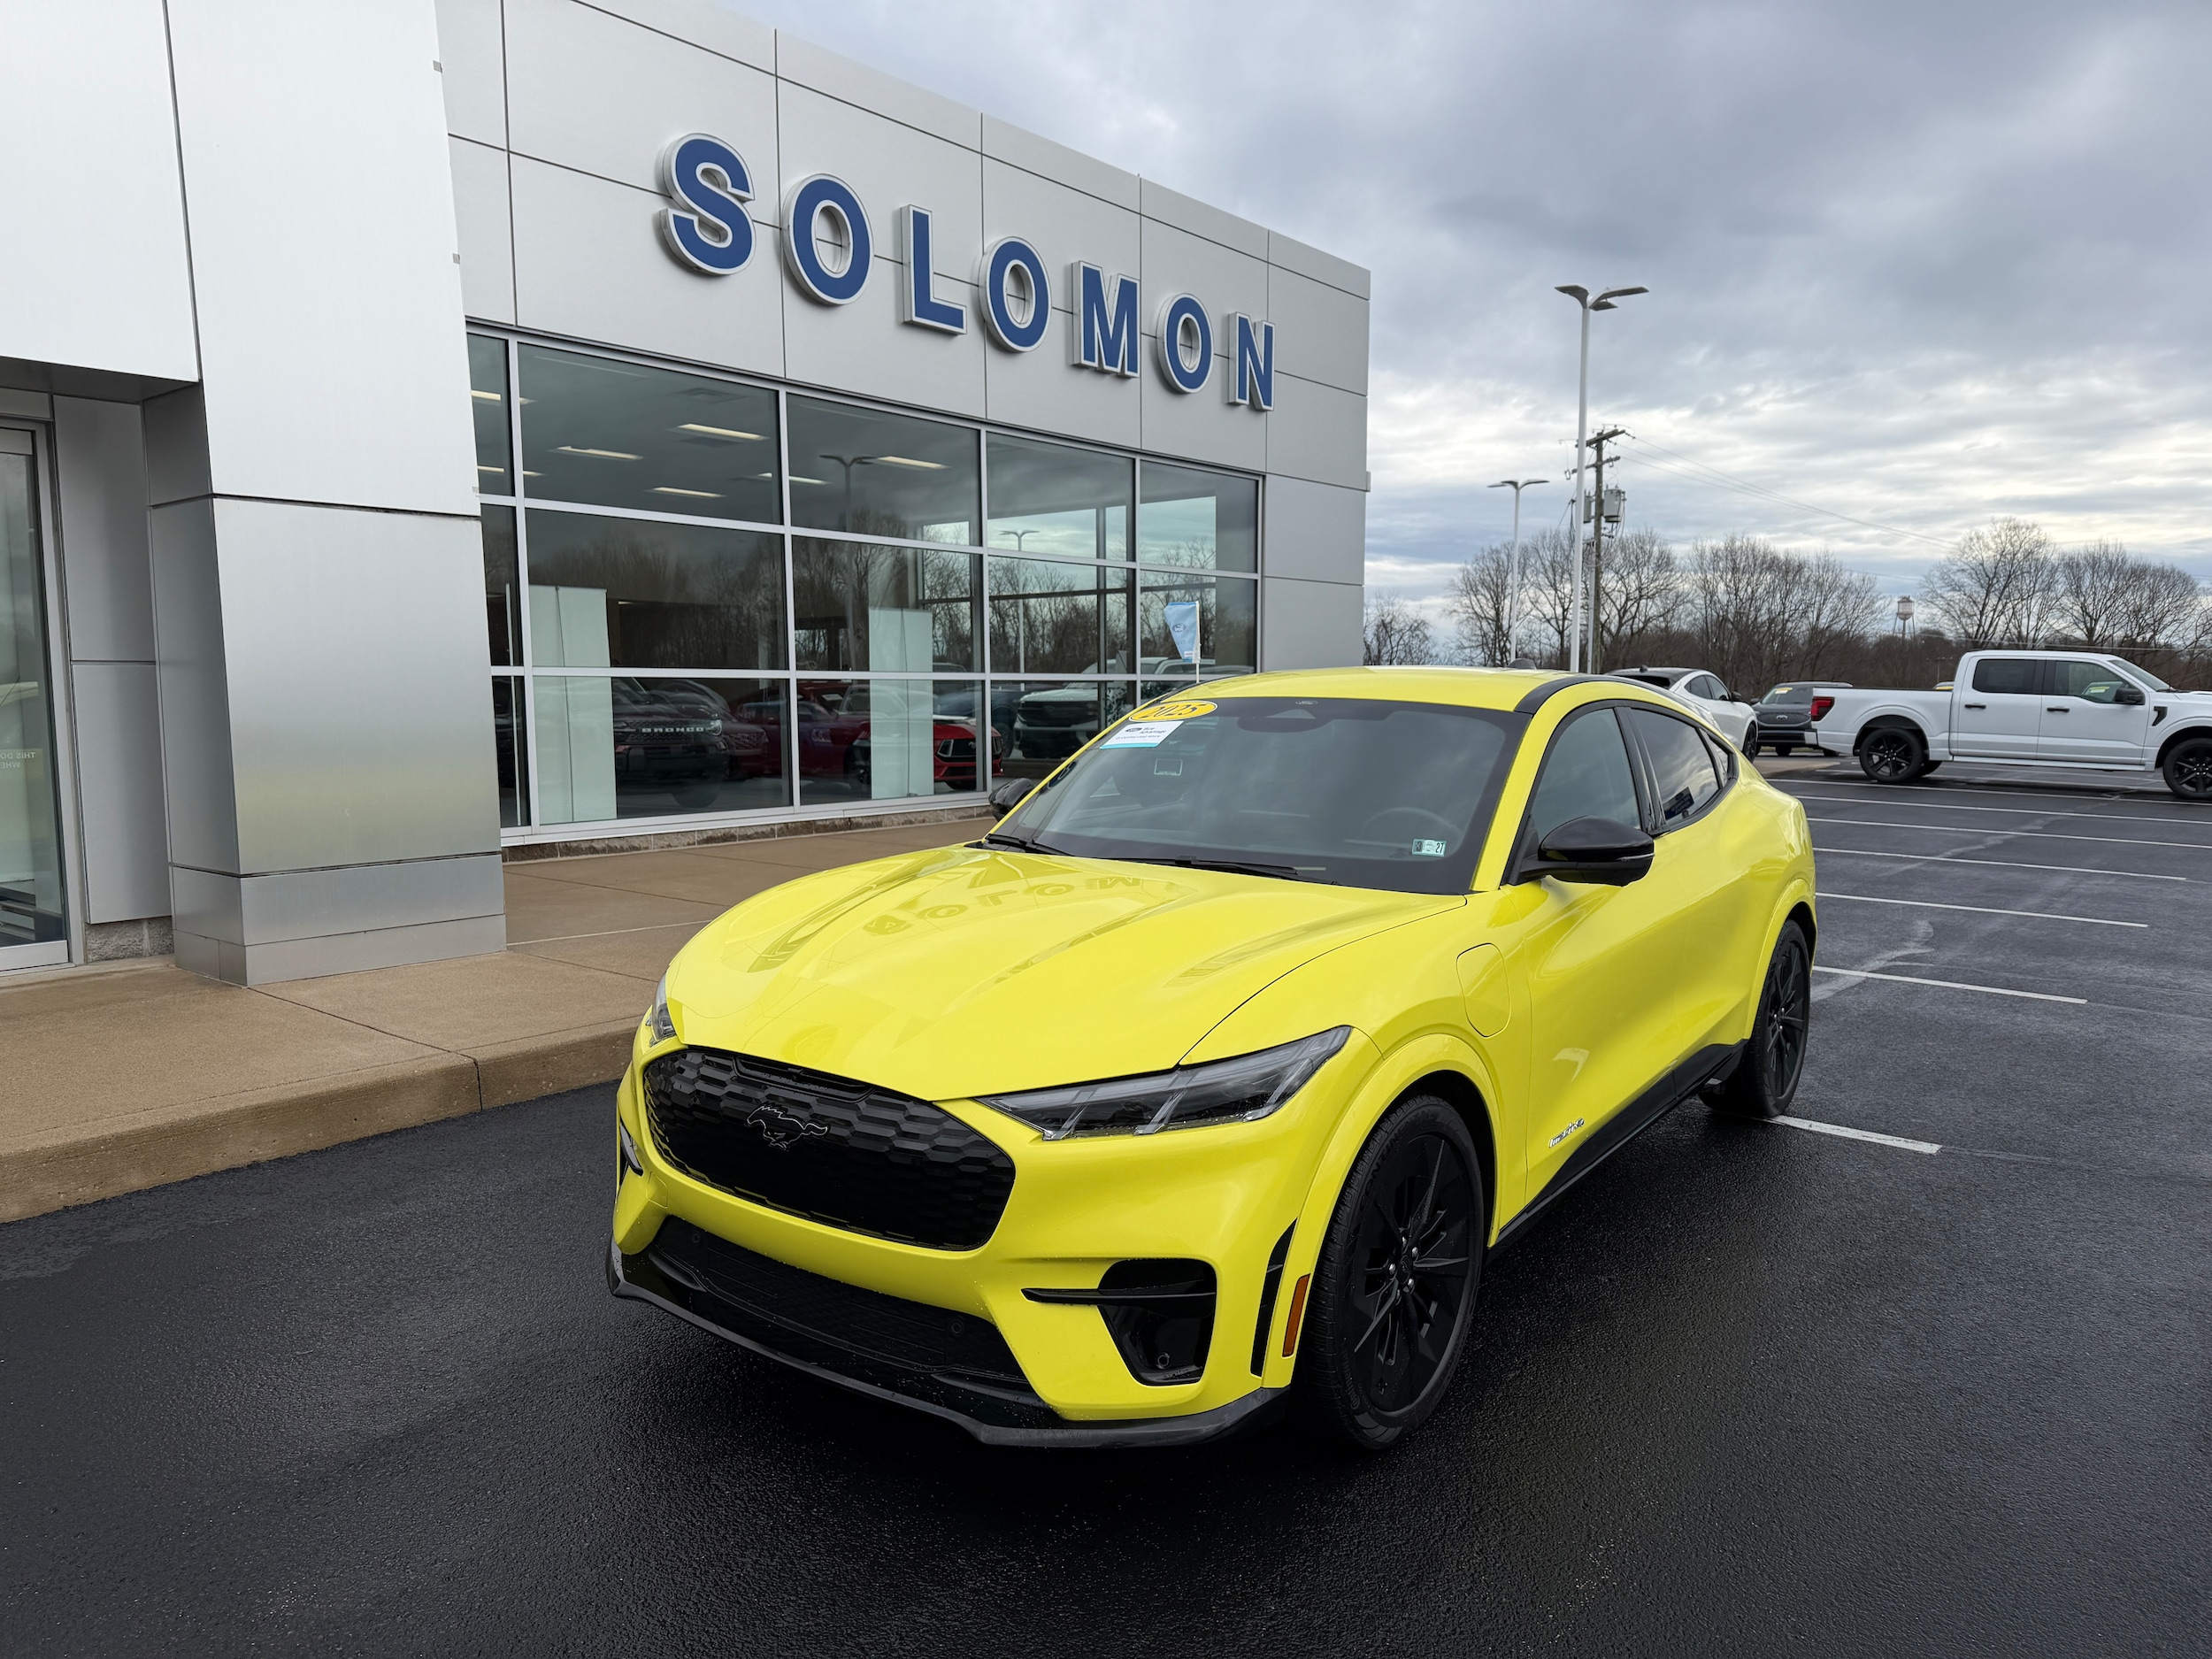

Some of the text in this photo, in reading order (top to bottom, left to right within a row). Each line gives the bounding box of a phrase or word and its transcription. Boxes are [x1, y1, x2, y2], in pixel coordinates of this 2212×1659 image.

[658, 133, 1276, 411] SOLOMON
[1137, 703, 1208, 718] 2025
[1417, 841, 1423, 851] 3
[1435, 842, 1444, 854] 27
